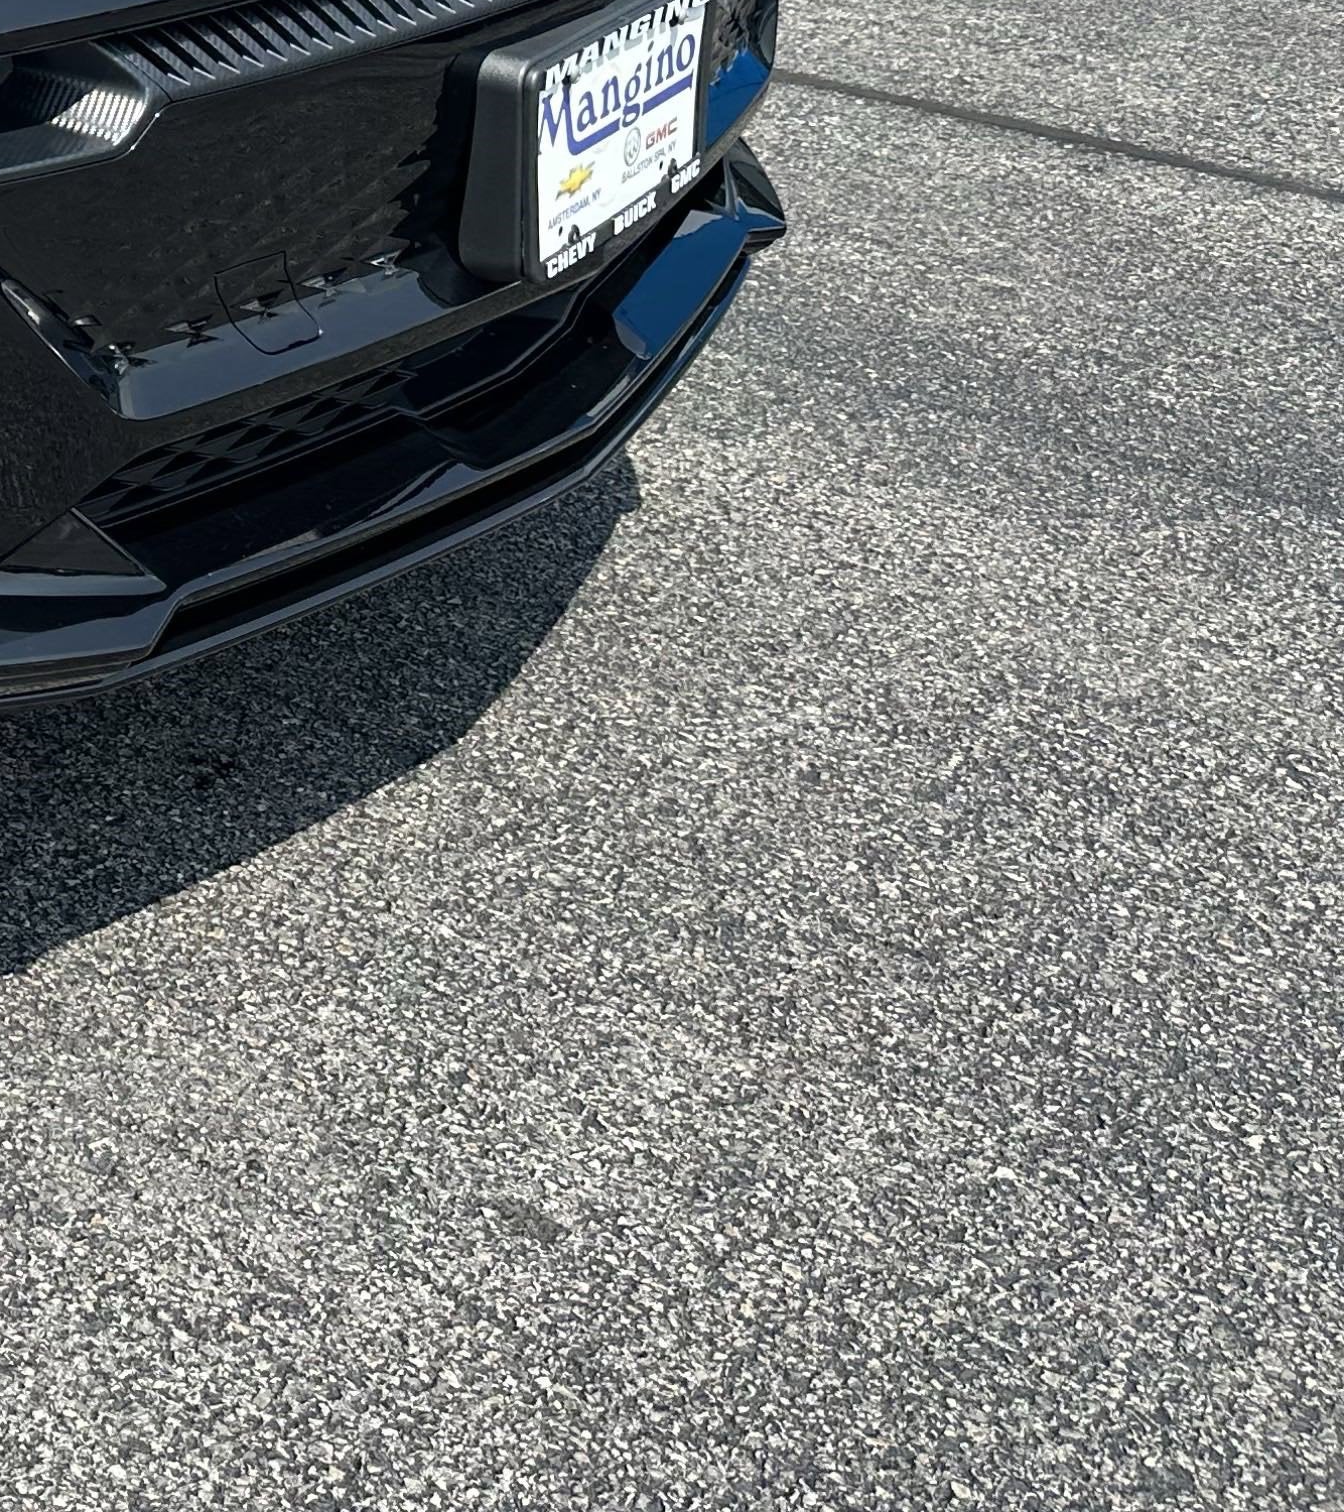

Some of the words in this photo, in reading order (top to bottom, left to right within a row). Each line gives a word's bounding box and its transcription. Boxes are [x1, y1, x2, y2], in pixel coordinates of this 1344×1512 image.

[538, 33, 696, 155] Mangino
[645, 116, 678, 150] GMC
[545, 232, 597, 279] CHEVY
[612, 191, 657, 236] BUICK
[670, 158, 701, 194] GMC
